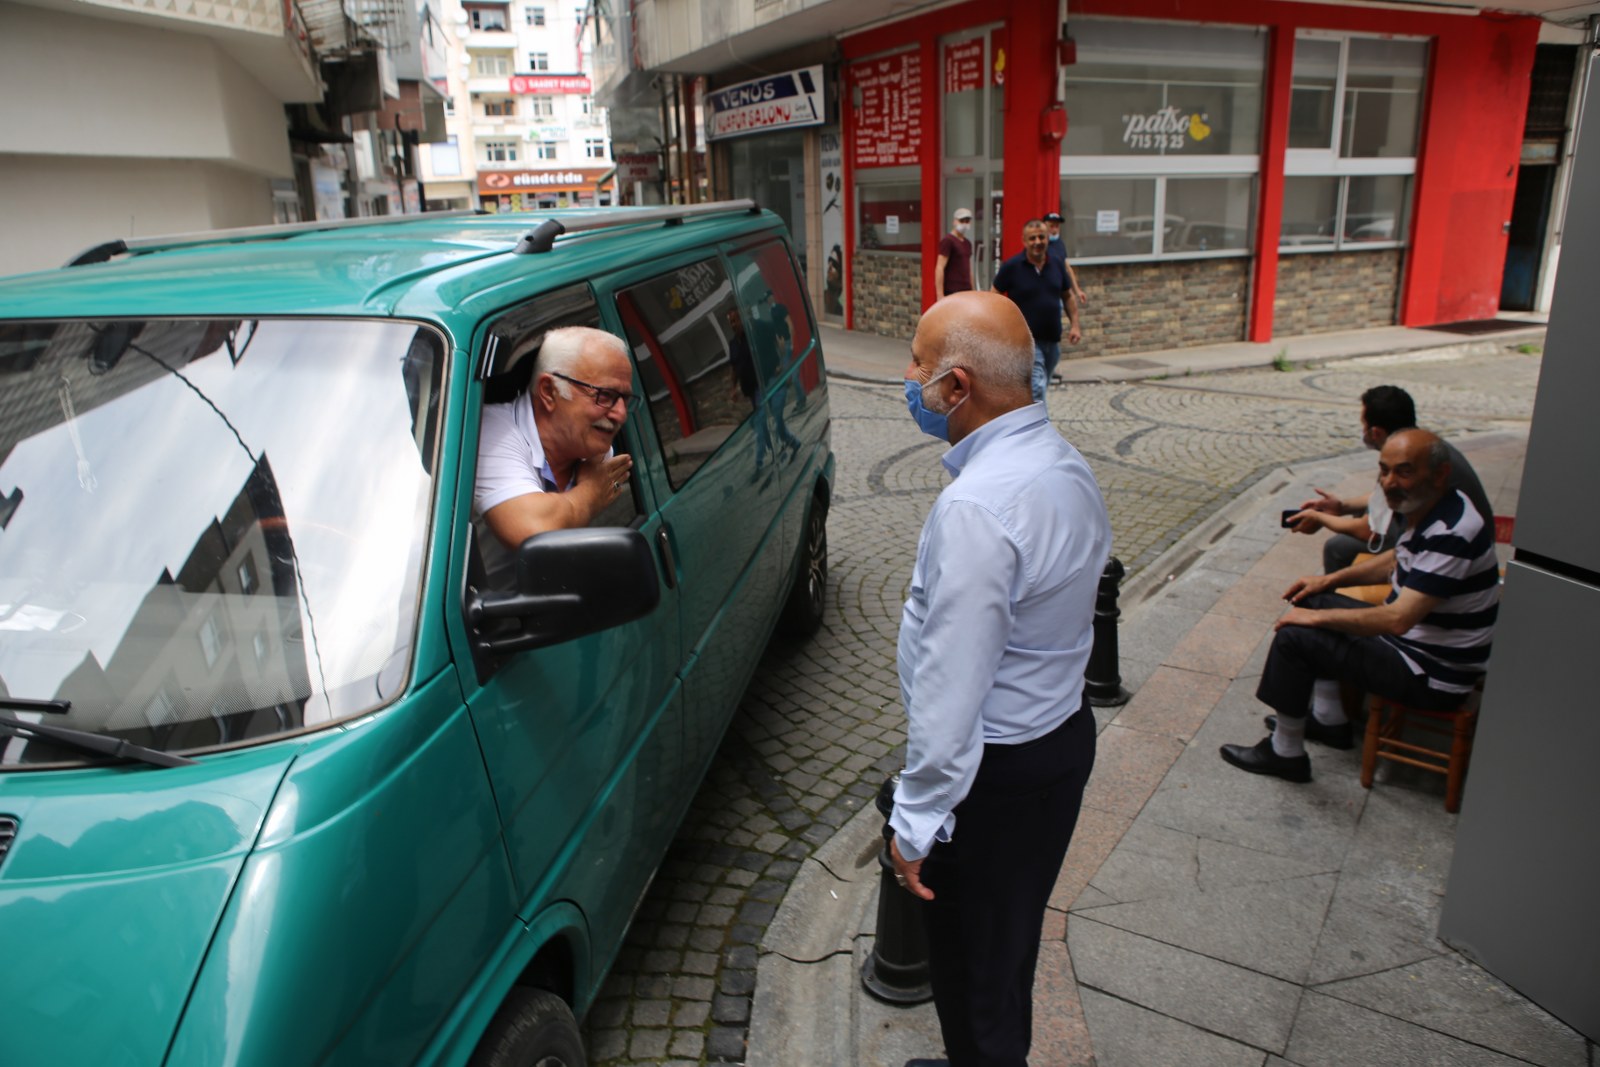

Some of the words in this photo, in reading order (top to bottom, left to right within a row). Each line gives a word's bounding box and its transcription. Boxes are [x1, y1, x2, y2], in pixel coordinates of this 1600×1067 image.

[721, 81, 776, 109] VENÜS
[748, 103, 792, 127] SALONU
[1130, 134, 1152, 148] 715
[1154, 134, 1168, 148] 75
[1169, 134, 1184, 148] 25
